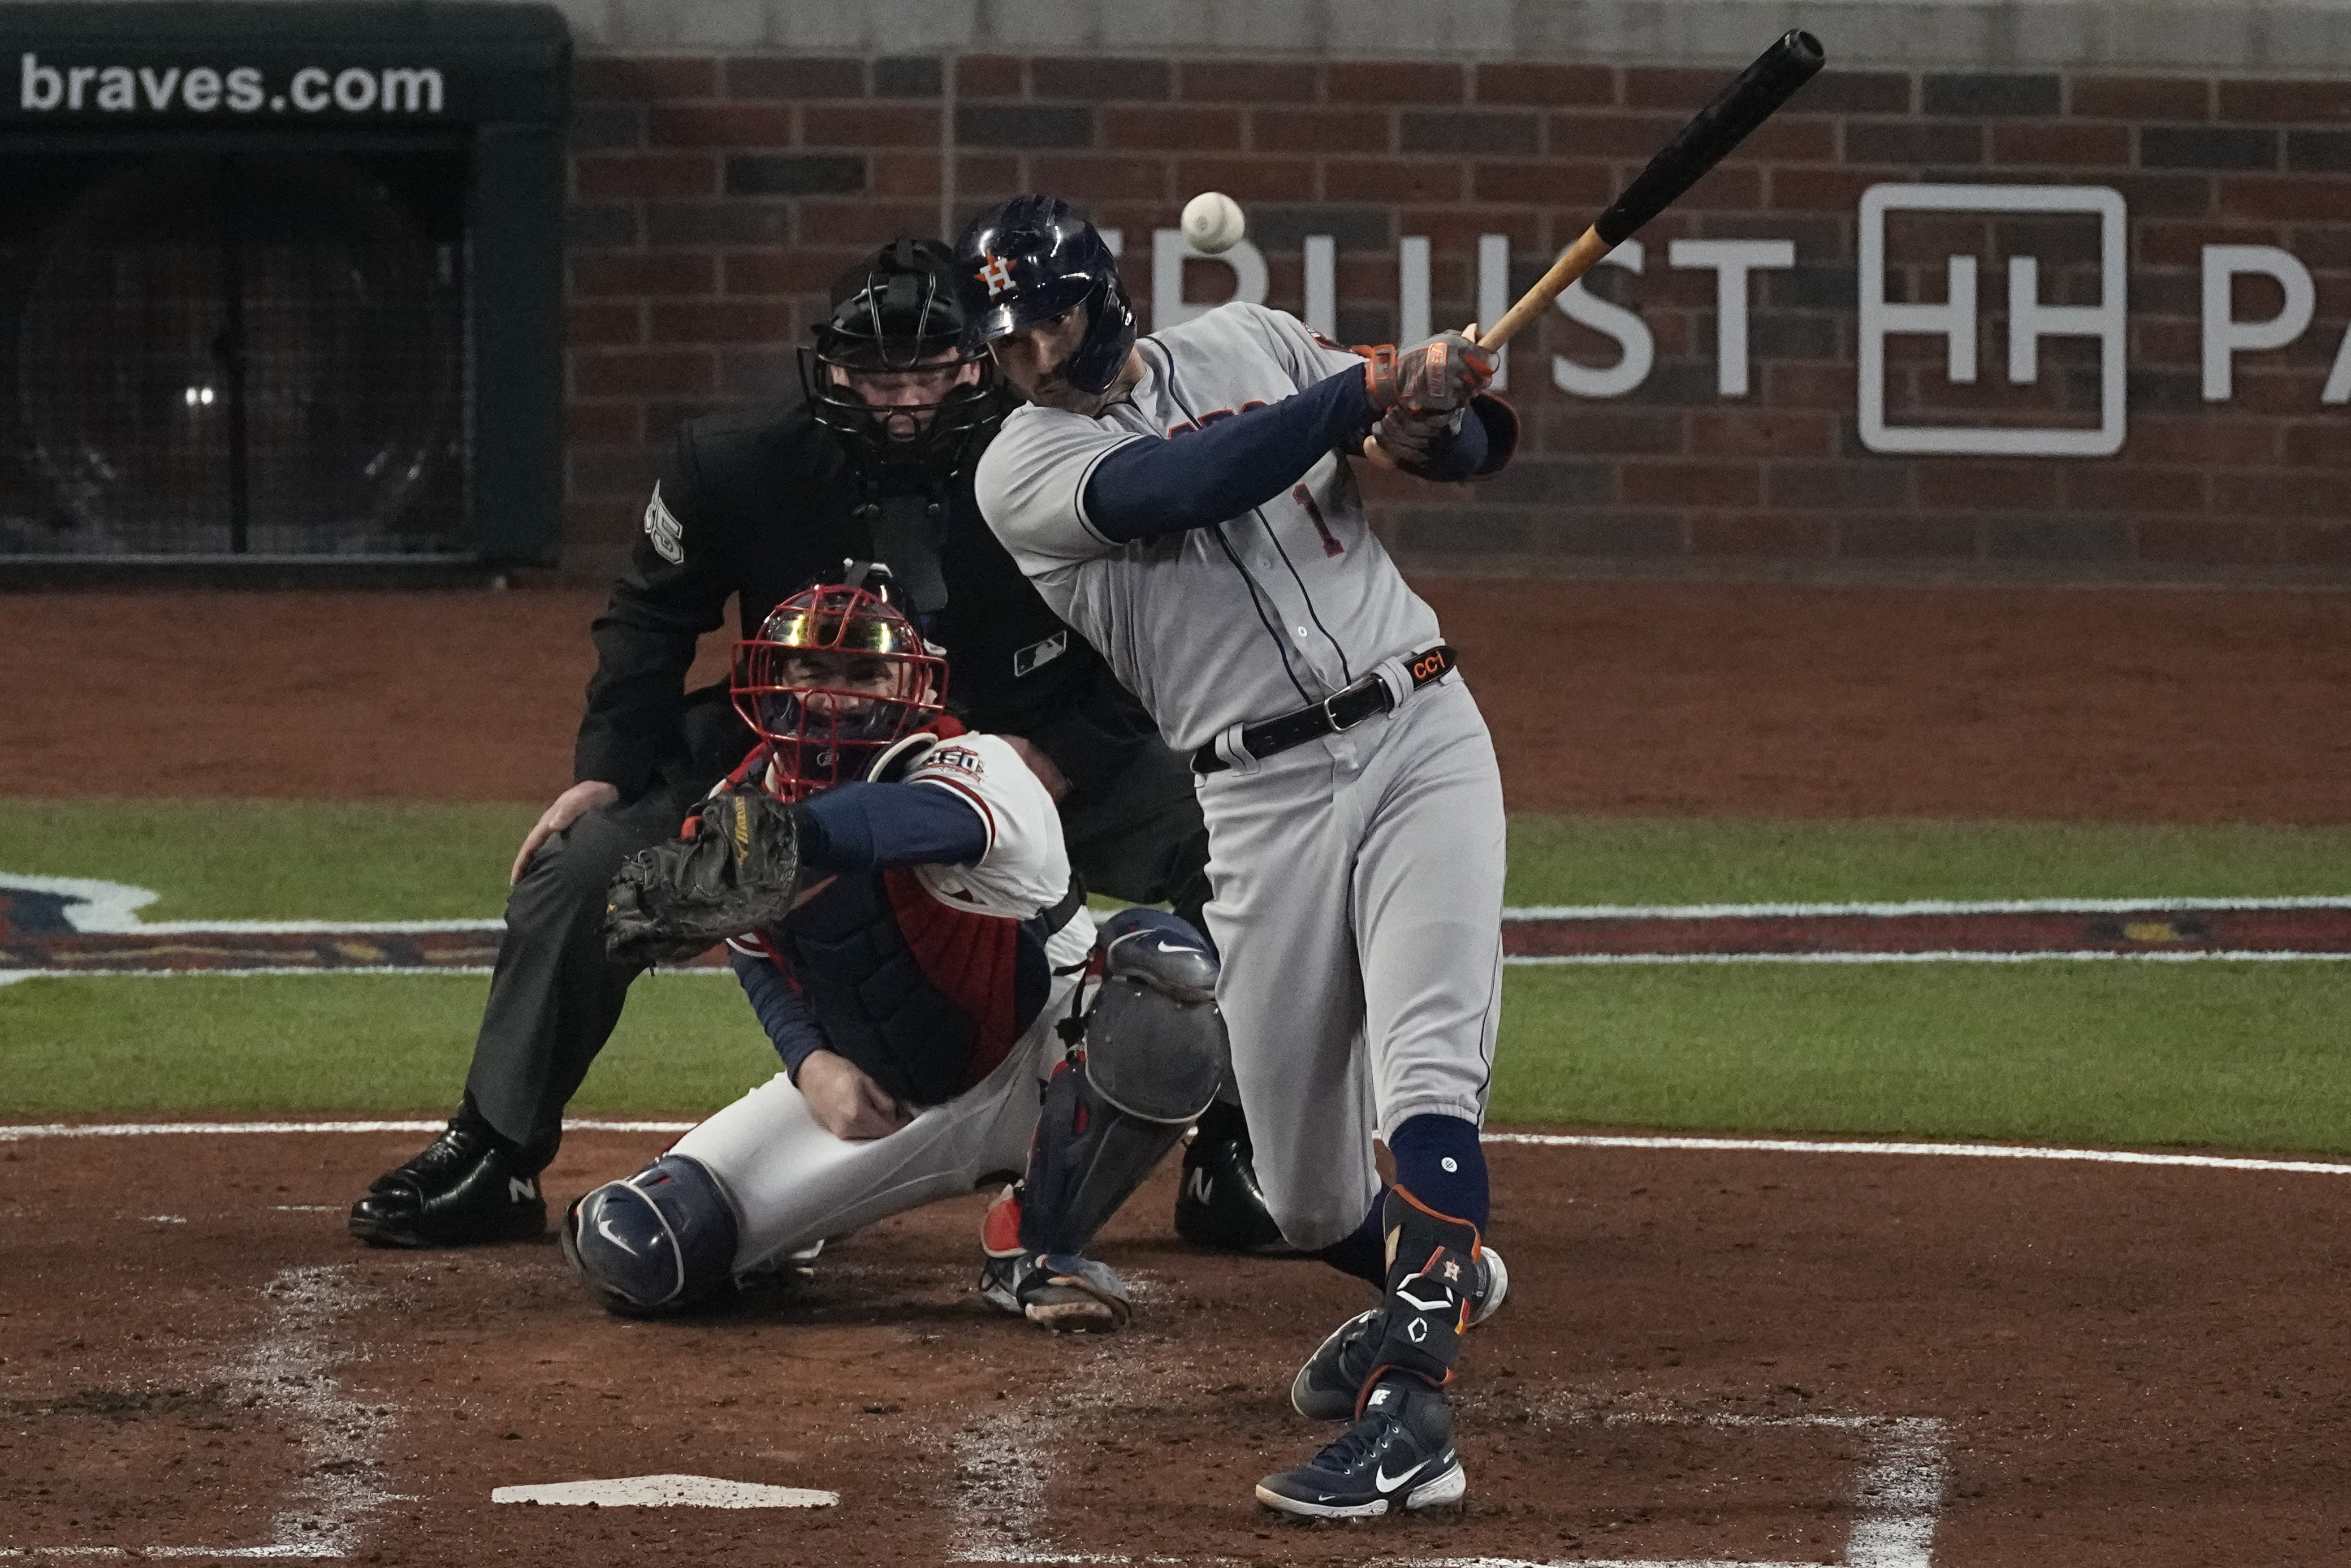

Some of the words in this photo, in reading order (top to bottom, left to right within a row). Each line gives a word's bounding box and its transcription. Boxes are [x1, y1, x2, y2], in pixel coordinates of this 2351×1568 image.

[20, 52, 444, 113] braves.com
[2201, 243, 2351, 405] P
[1293, 482, 1345, 558] 1
[509, 1176, 536, 1203] N
